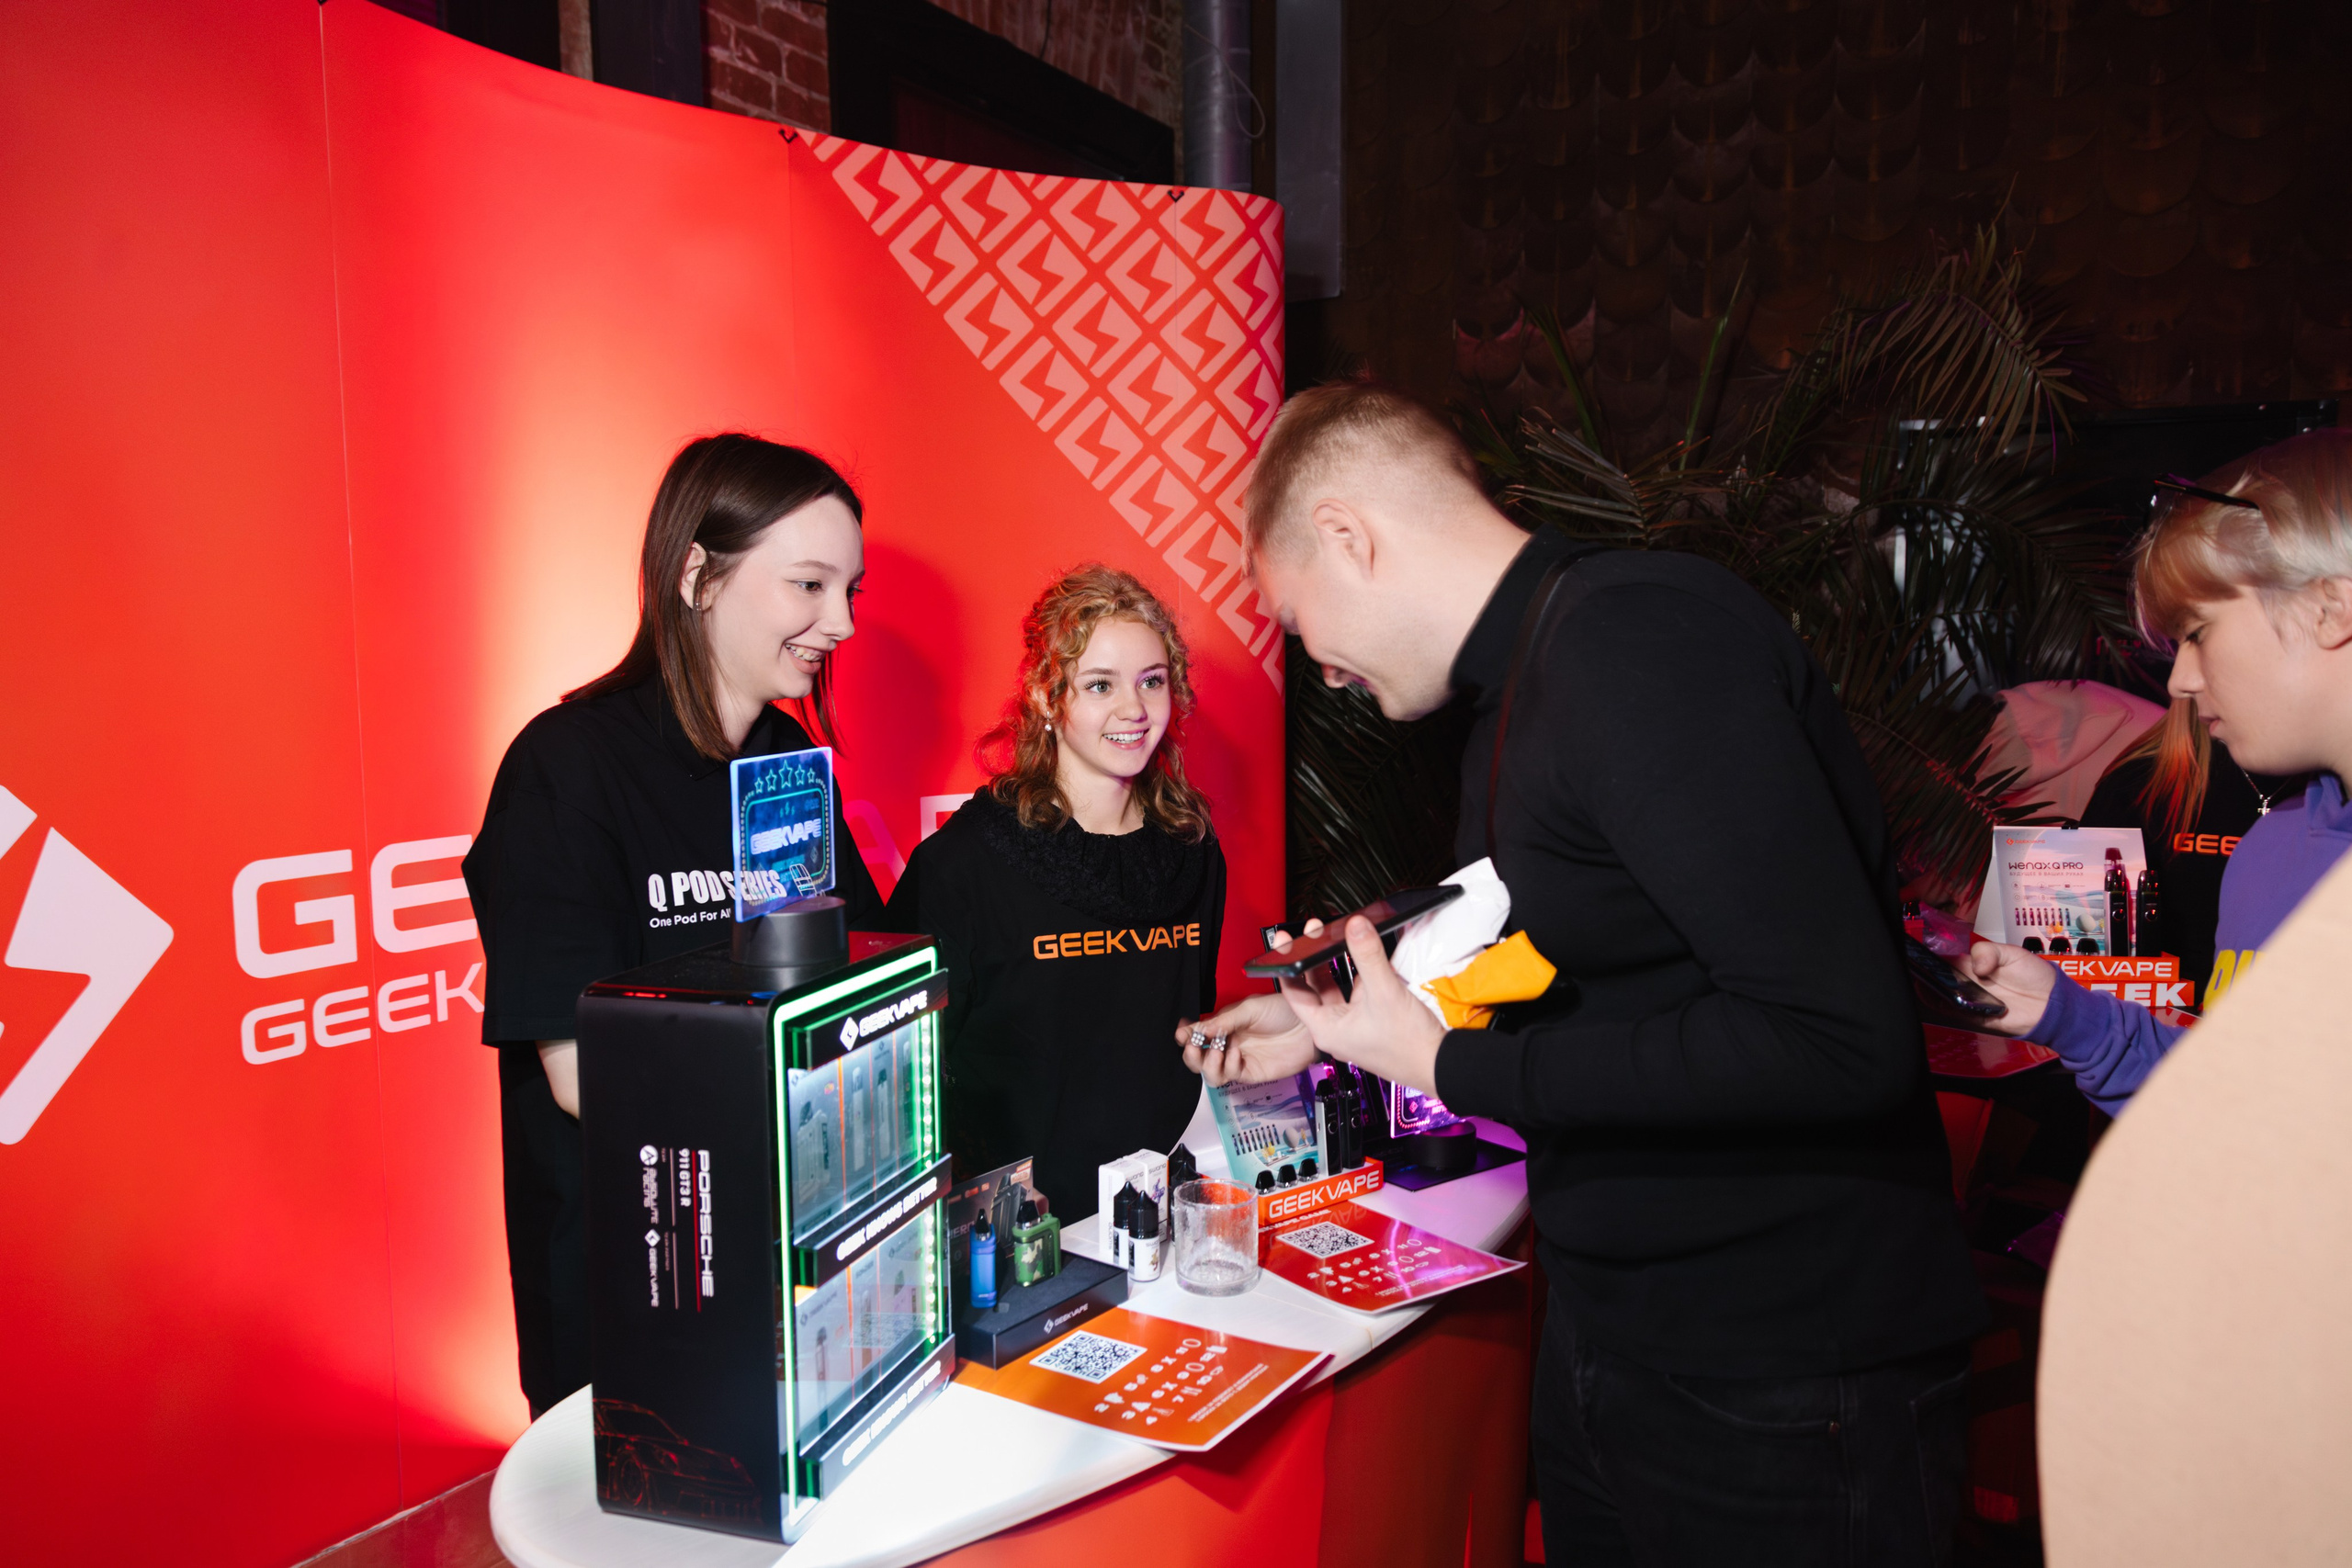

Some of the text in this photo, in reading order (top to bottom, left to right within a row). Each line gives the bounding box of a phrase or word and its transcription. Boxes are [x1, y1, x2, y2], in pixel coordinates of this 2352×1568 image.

[751, 818, 821, 855] GEEKVAPE
[2063, 862, 2084, 870] PRO
[648, 869, 787, 912] Q POD SERIES
[649, 908, 731, 929] One Pod For Al
[1033, 922, 1200, 960] GEEKVAPE
[2052, 960, 2173, 977] EKVAPE
[241, 962, 485, 1066] GEEK
[859, 990, 928, 1037] GEEKVAPE
[678, 1148, 691, 1208] 911 GT3 R
[1269, 1170, 1379, 1219] GEEKVAPE
[698, 1149, 714, 1297] PORSCHE
[649, 1247, 660, 1307] GEEKVAPE
[1055, 1303, 1088, 1326] GEEKVAPE
